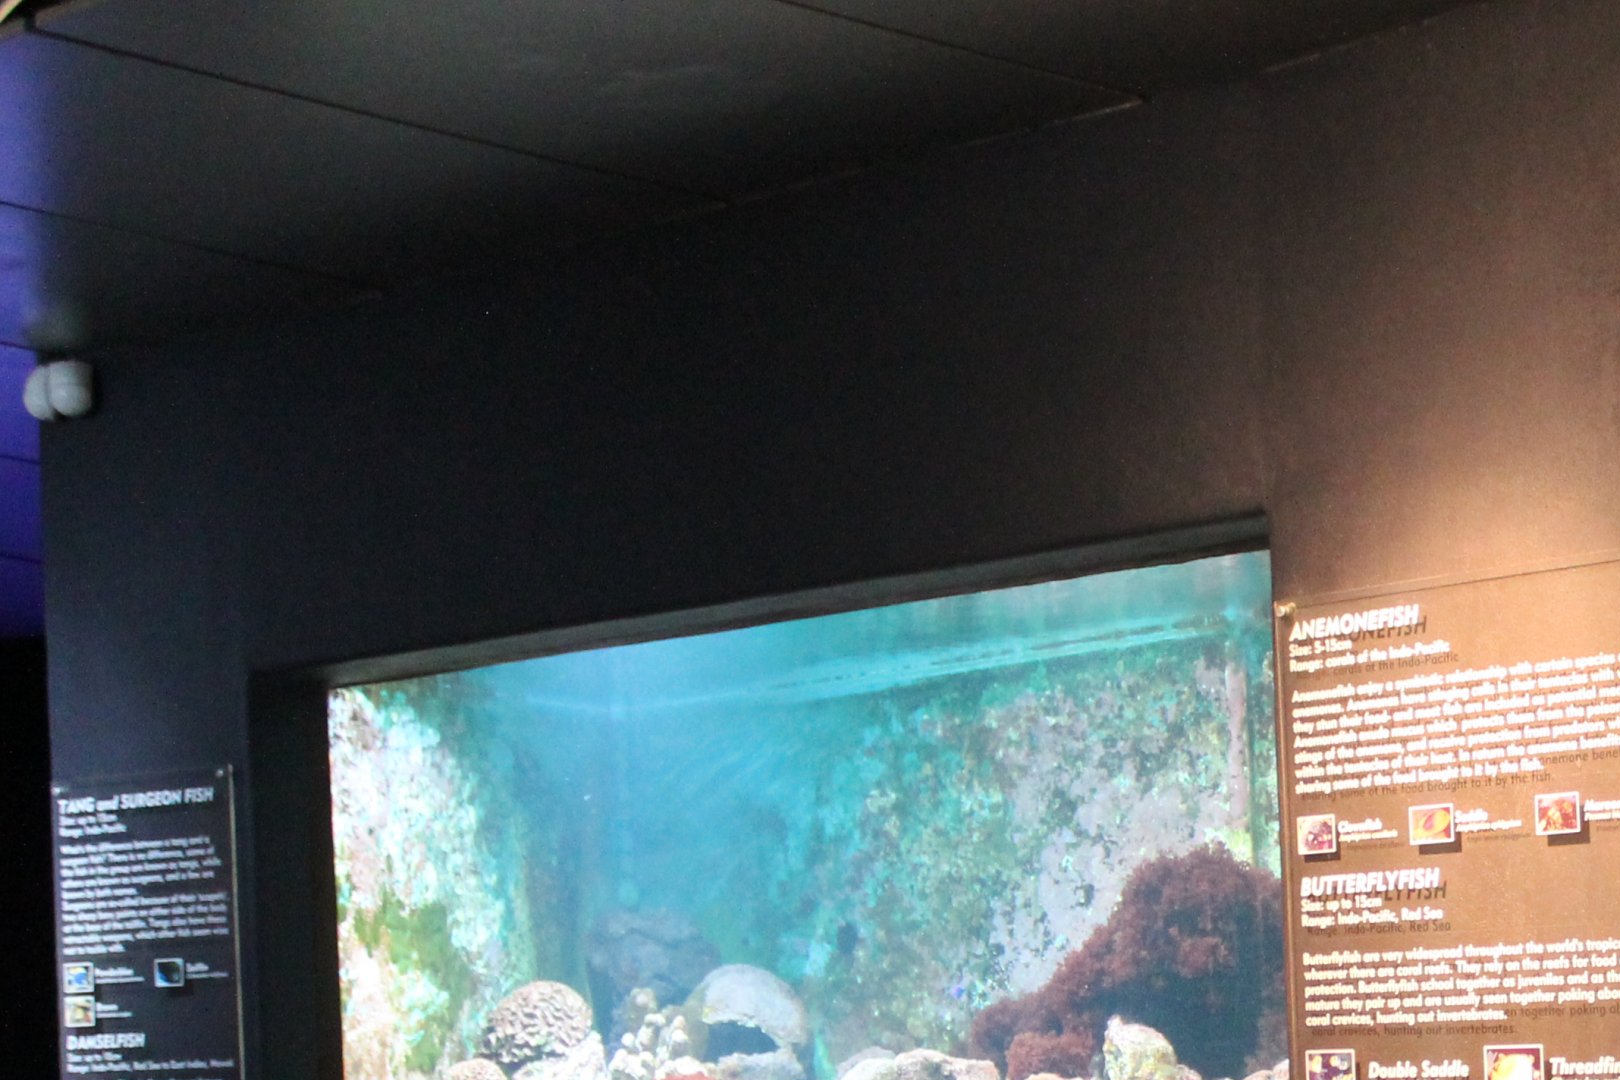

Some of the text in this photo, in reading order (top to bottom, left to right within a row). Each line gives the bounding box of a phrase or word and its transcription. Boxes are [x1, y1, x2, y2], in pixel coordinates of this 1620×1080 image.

[1289, 605, 1419, 640] ANEMONEFISH
[57, 787, 213, 814] TANG and SURGEON FISH
[1301, 868, 1440, 896] BUTTERFLYFISH
[1301, 895, 1382, 912] Size: up to 15cm
[1301, 907, 1443, 928] Range: Indo-Pacific, Red Sea
[1303, 950, 1361, 967] Butterflyfish
[1363, 953, 1380, 962] are
[1383, 952, 1403, 964] very
[1406, 945, 1462, 962] widespread
[1465, 942, 1523, 959] throughout
[1526, 942, 1543, 954] the
[1546, 940, 1584, 953] world's
[1306, 1008, 1508, 1027] coral crevices, hunting out invertebrates.
[1368, 1060, 1469, 1078] Double Saddle
